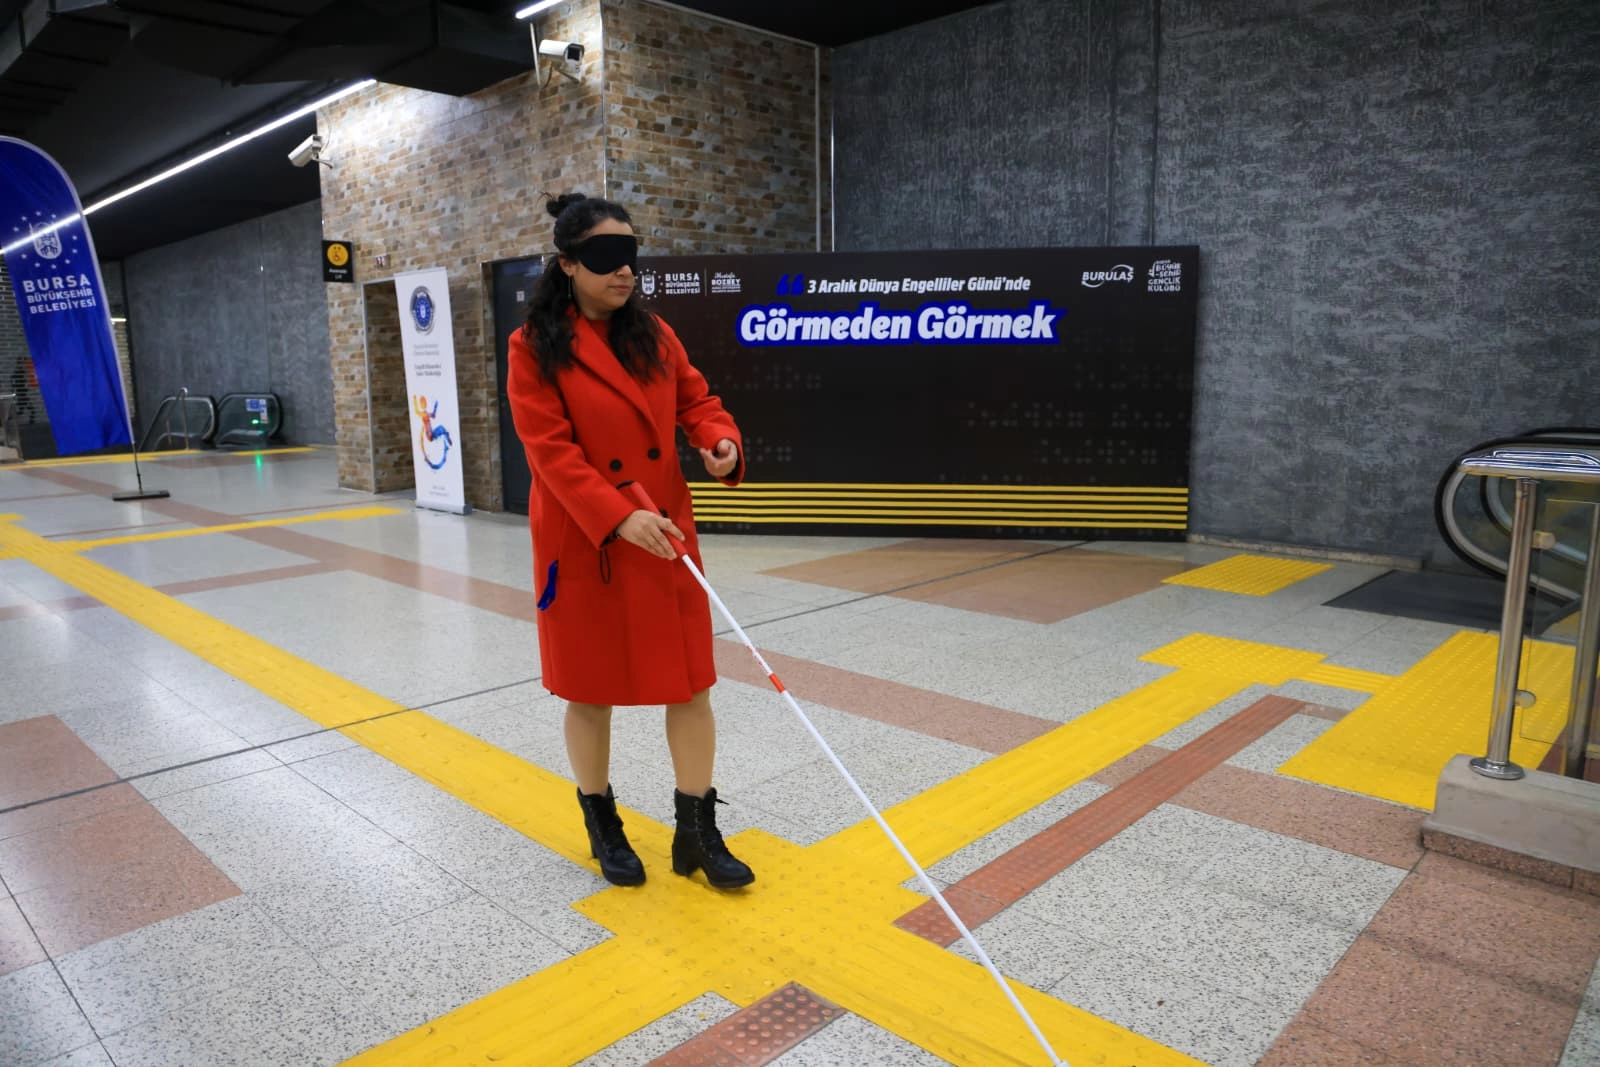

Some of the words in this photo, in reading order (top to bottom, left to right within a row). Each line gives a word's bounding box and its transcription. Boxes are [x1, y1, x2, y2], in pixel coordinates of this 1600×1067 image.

[22, 273, 91, 293] BURSA
[665, 272, 699, 281] BURSA
[807, 280, 817, 293] 3
[818, 279, 858, 293] Aralık
[858, 278, 900, 294] Dünya
[901, 277, 965, 294] Engelliler
[967, 276, 1031, 291] Günü'nde
[1082, 271, 1134, 283] BURULAŞ
[29, 296, 97, 314] BELEDİYESİ
[741, 307, 912, 342] Görmeden
[917, 305, 1057, 340] Görmek
